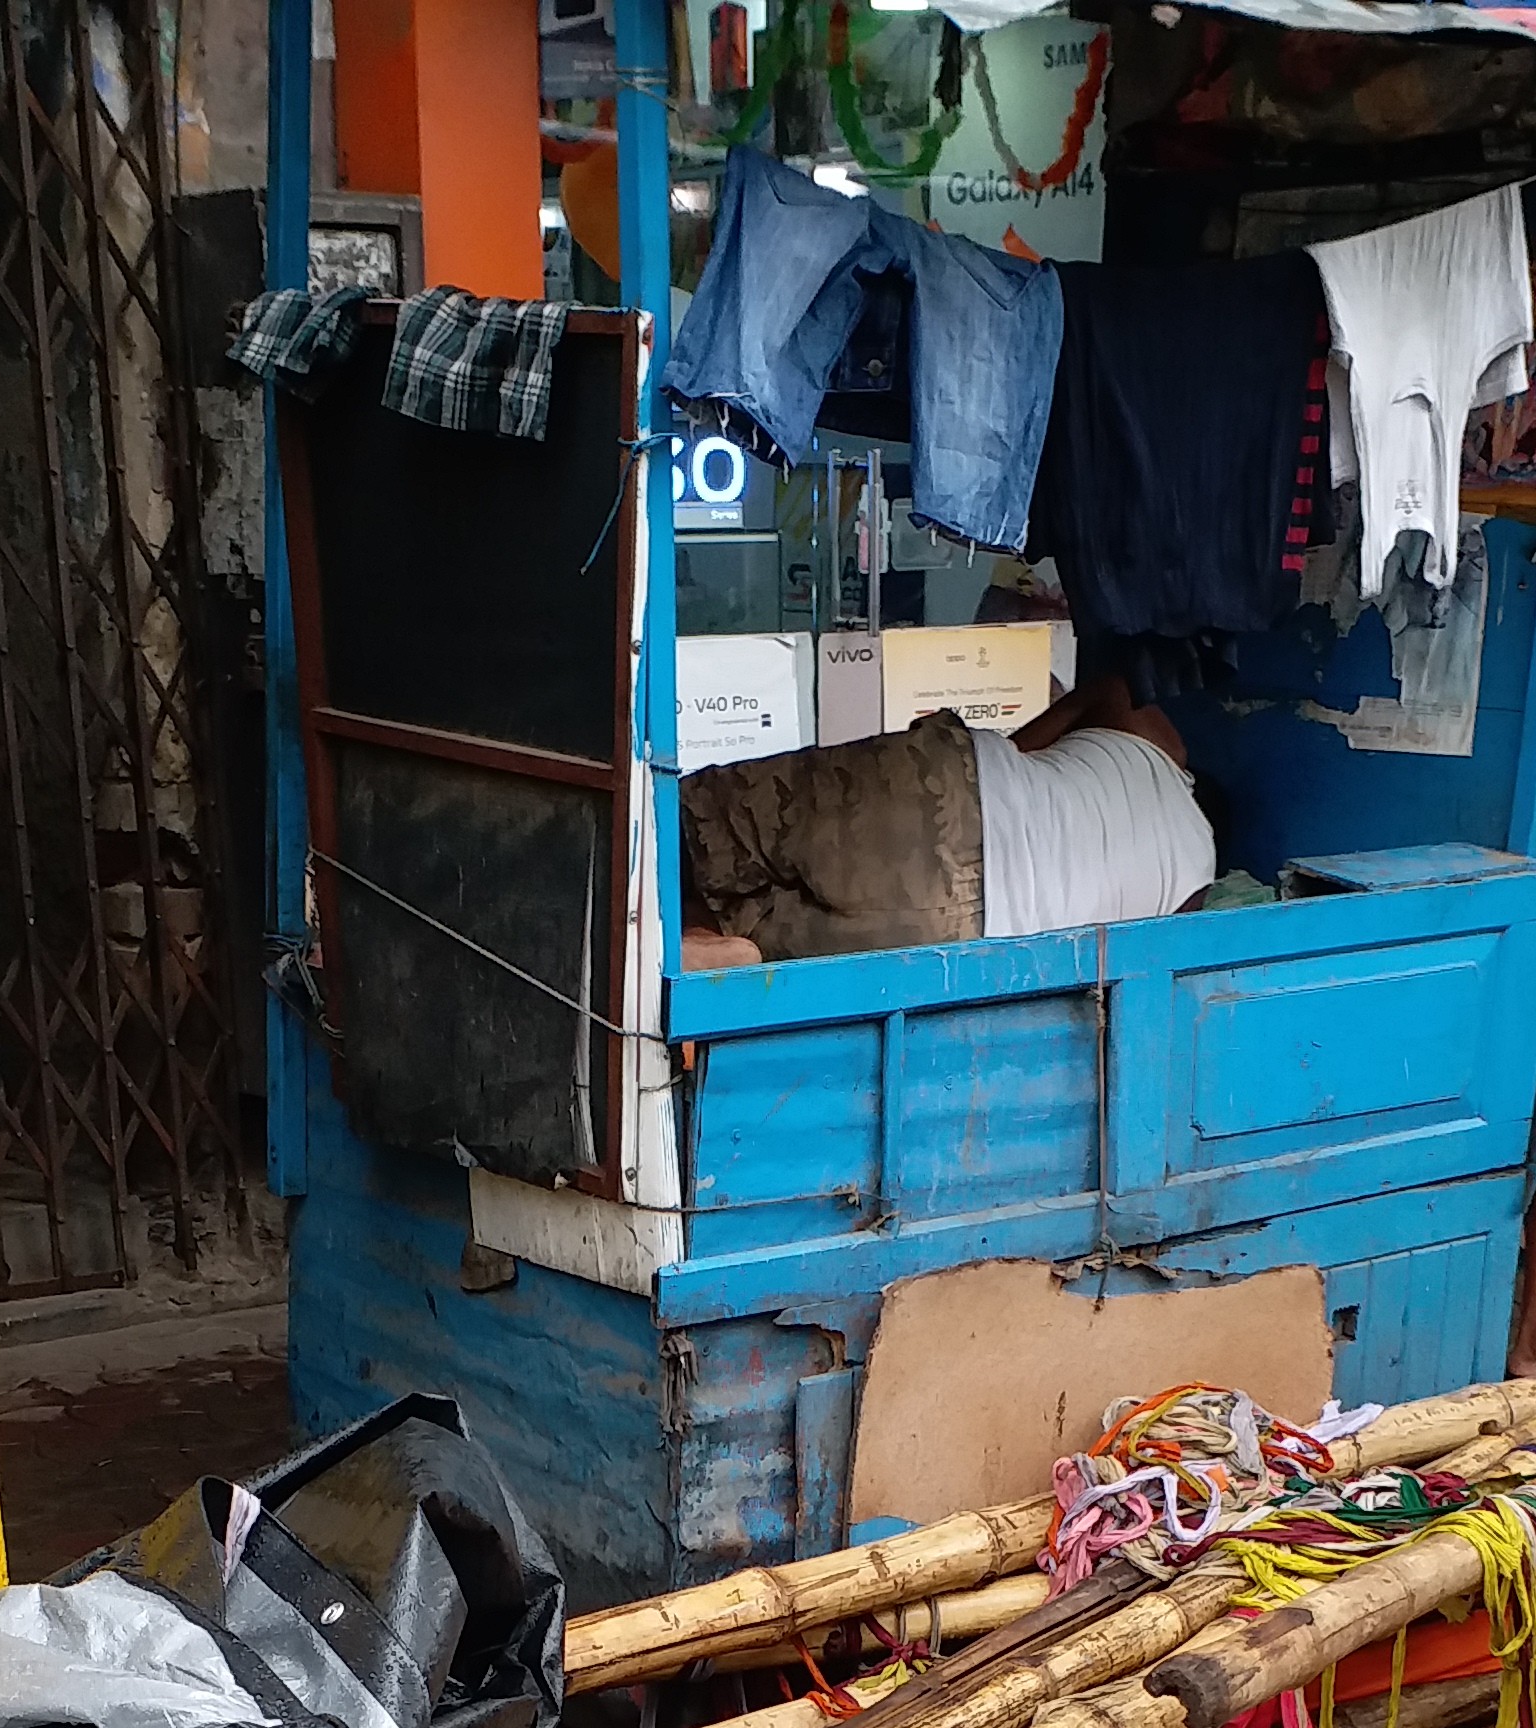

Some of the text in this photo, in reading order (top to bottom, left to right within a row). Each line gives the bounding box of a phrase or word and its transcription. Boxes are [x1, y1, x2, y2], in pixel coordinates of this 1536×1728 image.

[1043, 42, 1088, 69] SAM
[827, 648, 874, 664] vivo
[694, 696, 728, 713] V40
[732, 695, 759, 711] Pro
